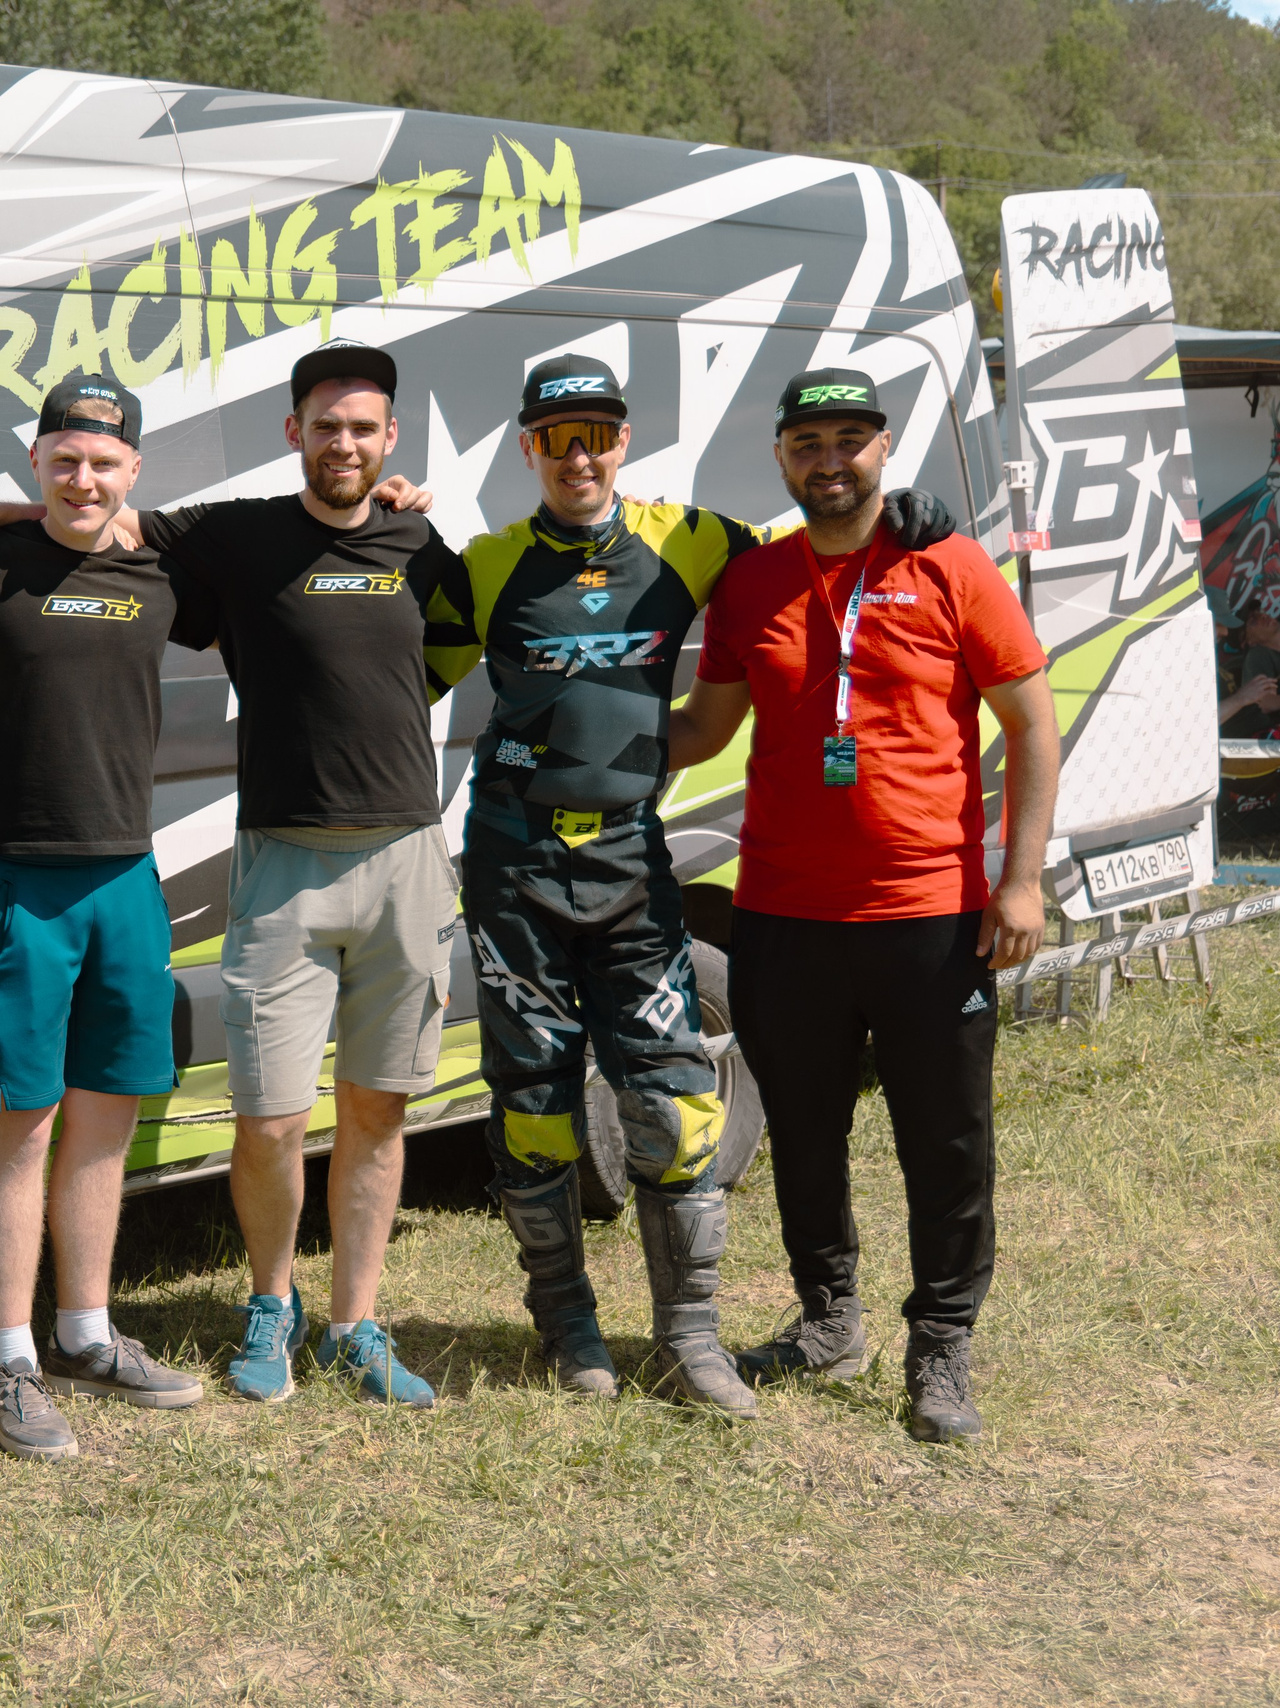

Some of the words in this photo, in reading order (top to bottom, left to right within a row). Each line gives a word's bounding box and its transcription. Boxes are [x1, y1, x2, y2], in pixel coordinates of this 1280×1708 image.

[350, 131, 581, 318] TEAM
[539, 377, 605, 399] BRZ
[798, 385, 868, 406] BRZ
[314, 578, 367, 591] BRZ
[51, 599, 104, 614] BRZ
[522, 630, 670, 678] BRZ
[500, 738, 530, 752] bike
[496, 747, 532, 760] RIDE
[495, 756, 538, 769] ZONE
[961, 1001, 988, 1013] adidas
